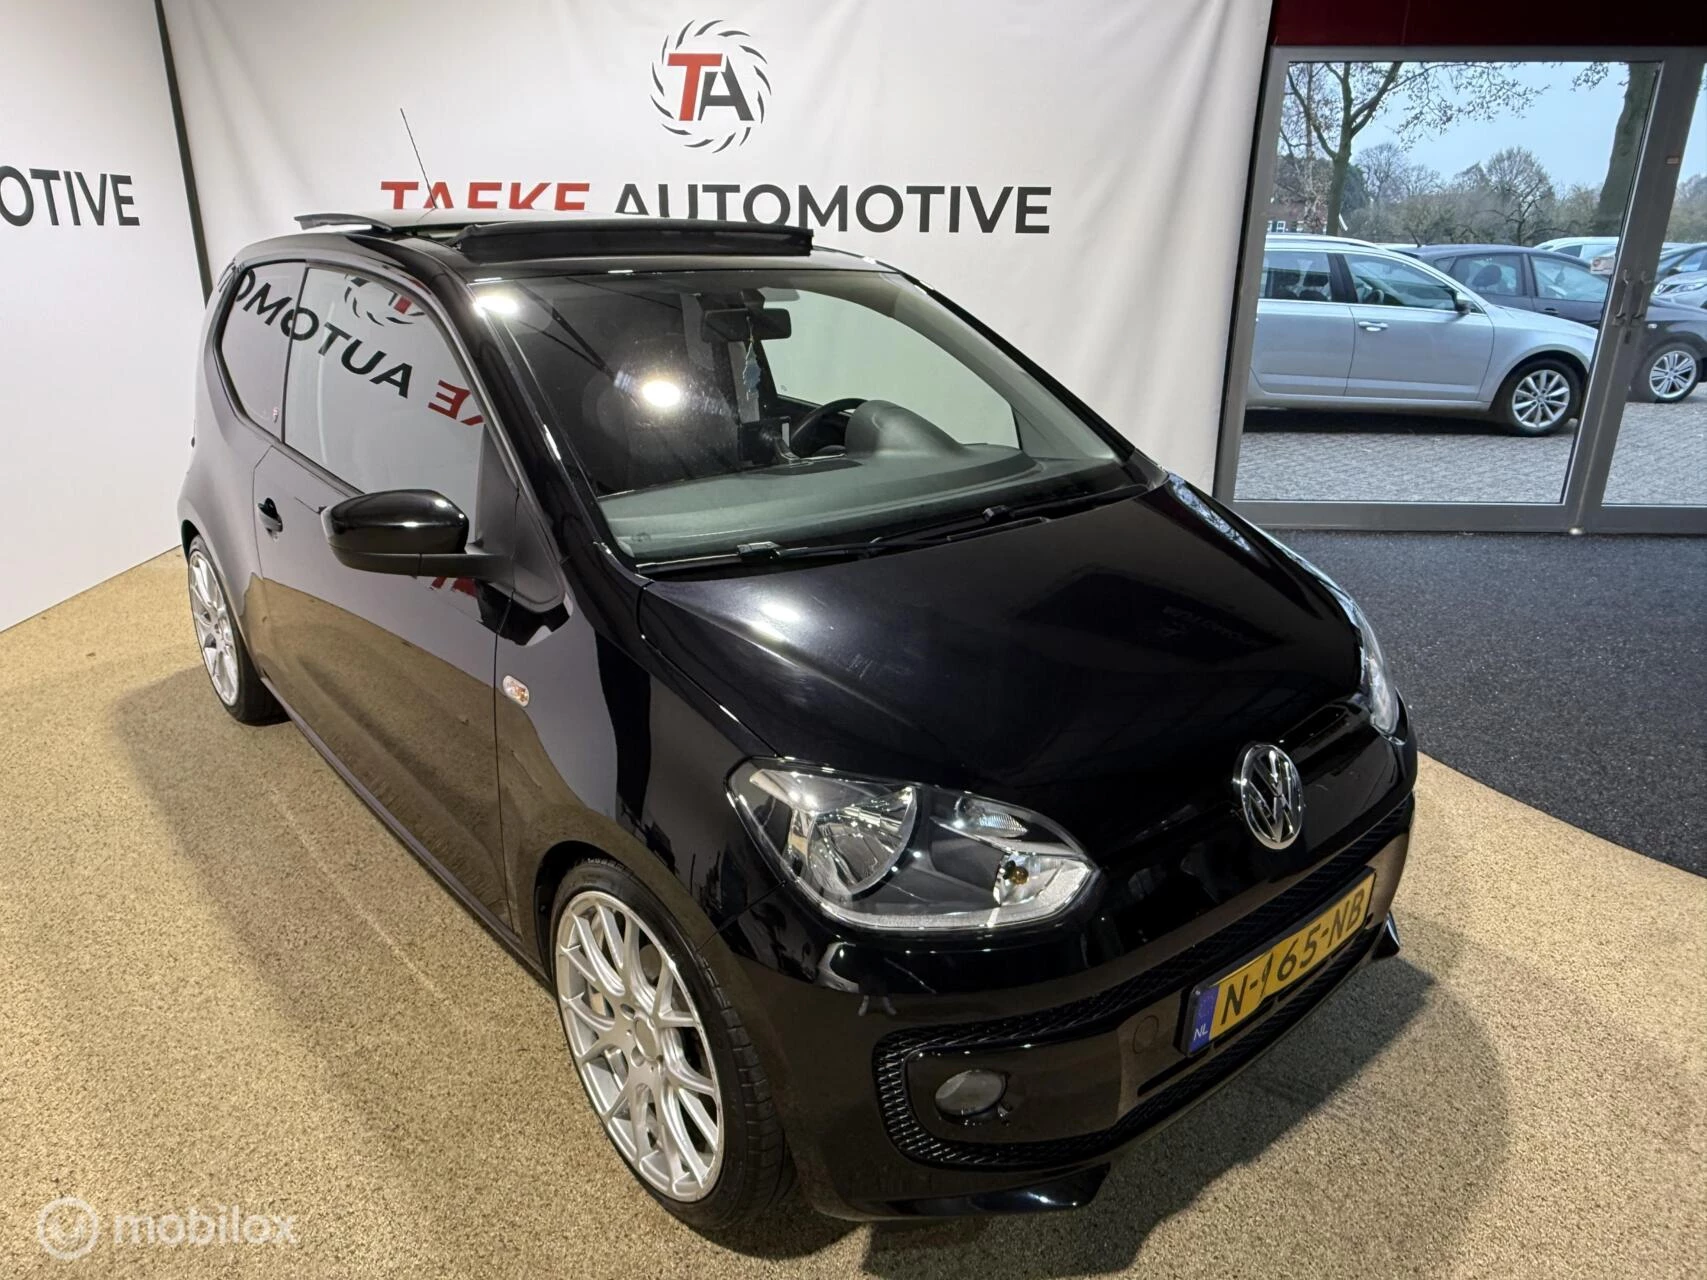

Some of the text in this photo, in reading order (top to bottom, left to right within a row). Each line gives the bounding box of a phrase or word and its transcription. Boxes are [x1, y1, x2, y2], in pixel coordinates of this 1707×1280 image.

[667, 53, 755, 121] TA
[615, 183, 1052, 233] AUTOMOTIVE
[1193, 1023, 1208, 1041] NL
